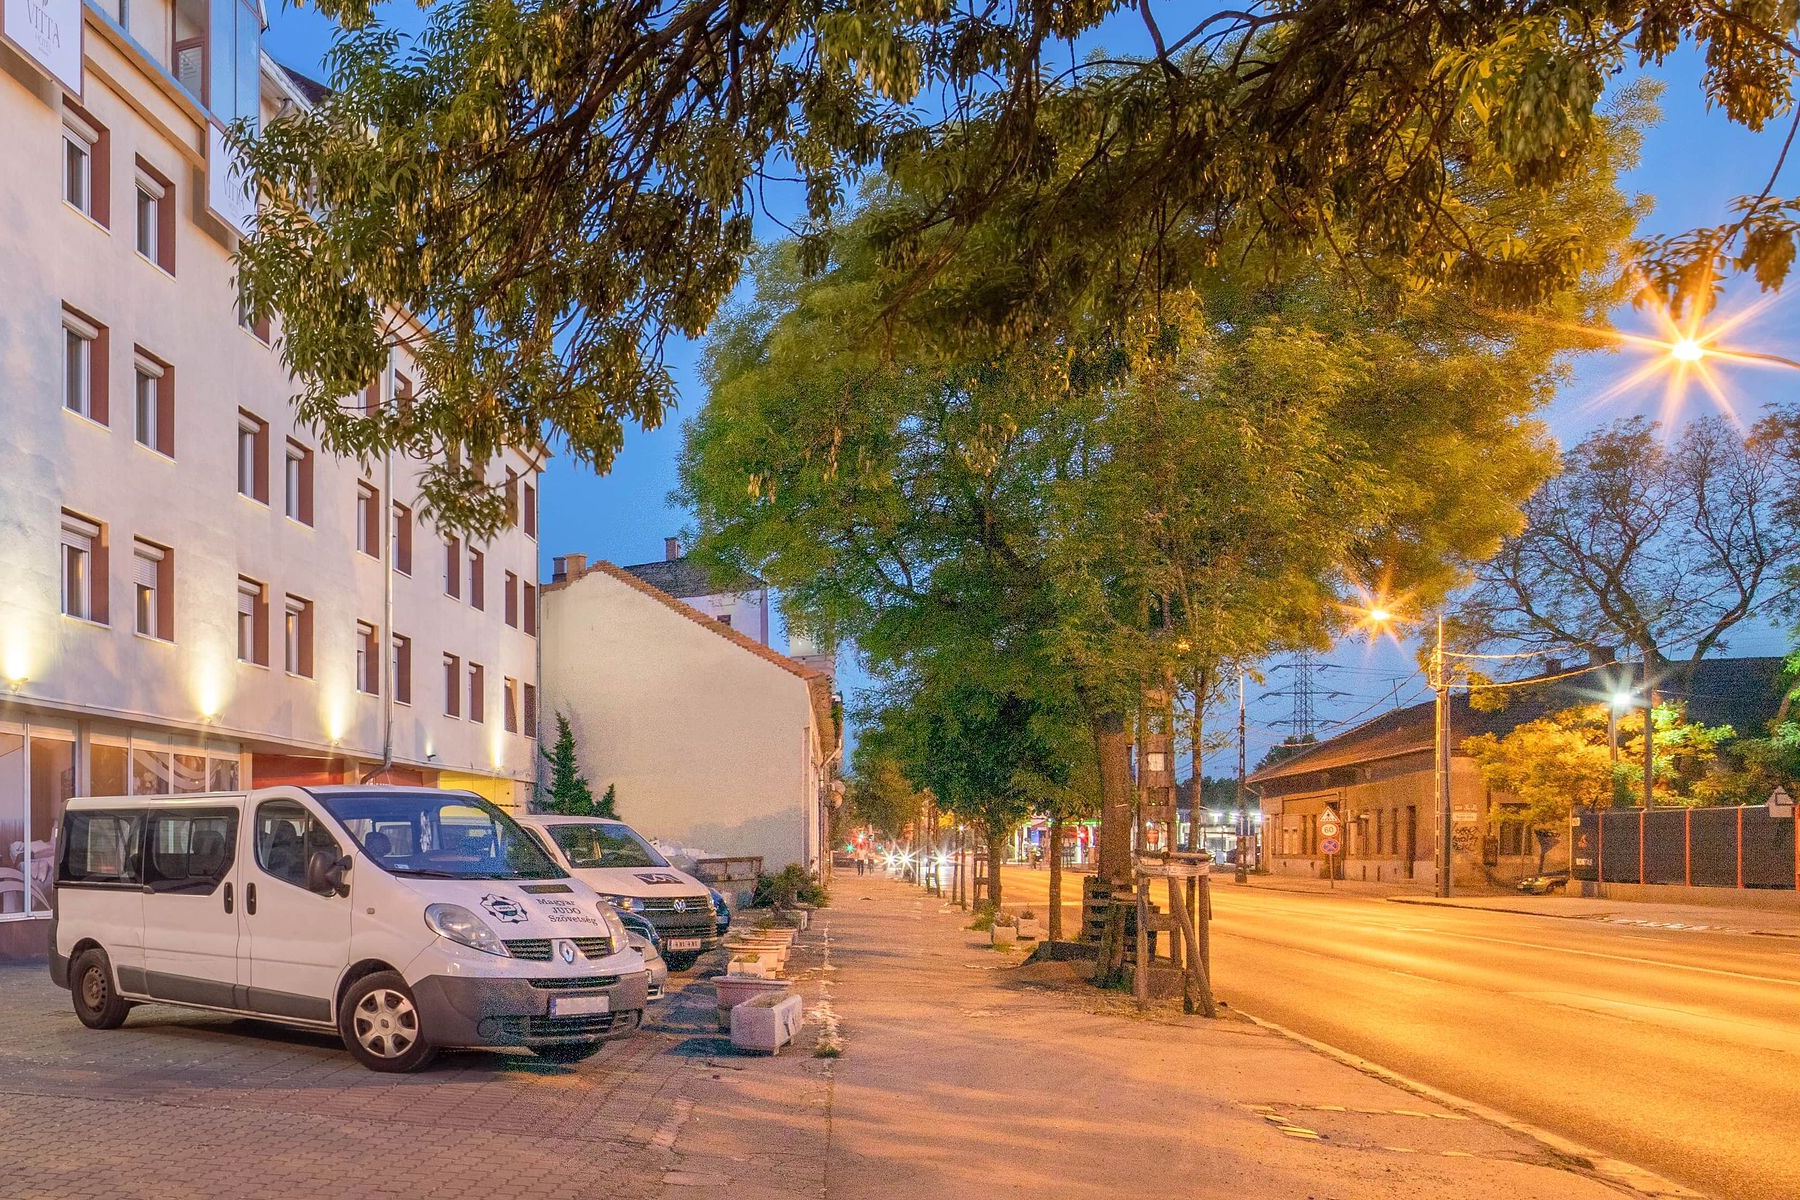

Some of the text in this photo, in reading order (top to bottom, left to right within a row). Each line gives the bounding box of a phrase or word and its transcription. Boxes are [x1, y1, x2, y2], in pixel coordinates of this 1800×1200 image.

[536, 898, 575, 907] Magyar
[551, 907, 581, 915] JUDO
[548, 914, 598, 926] Szövetség
